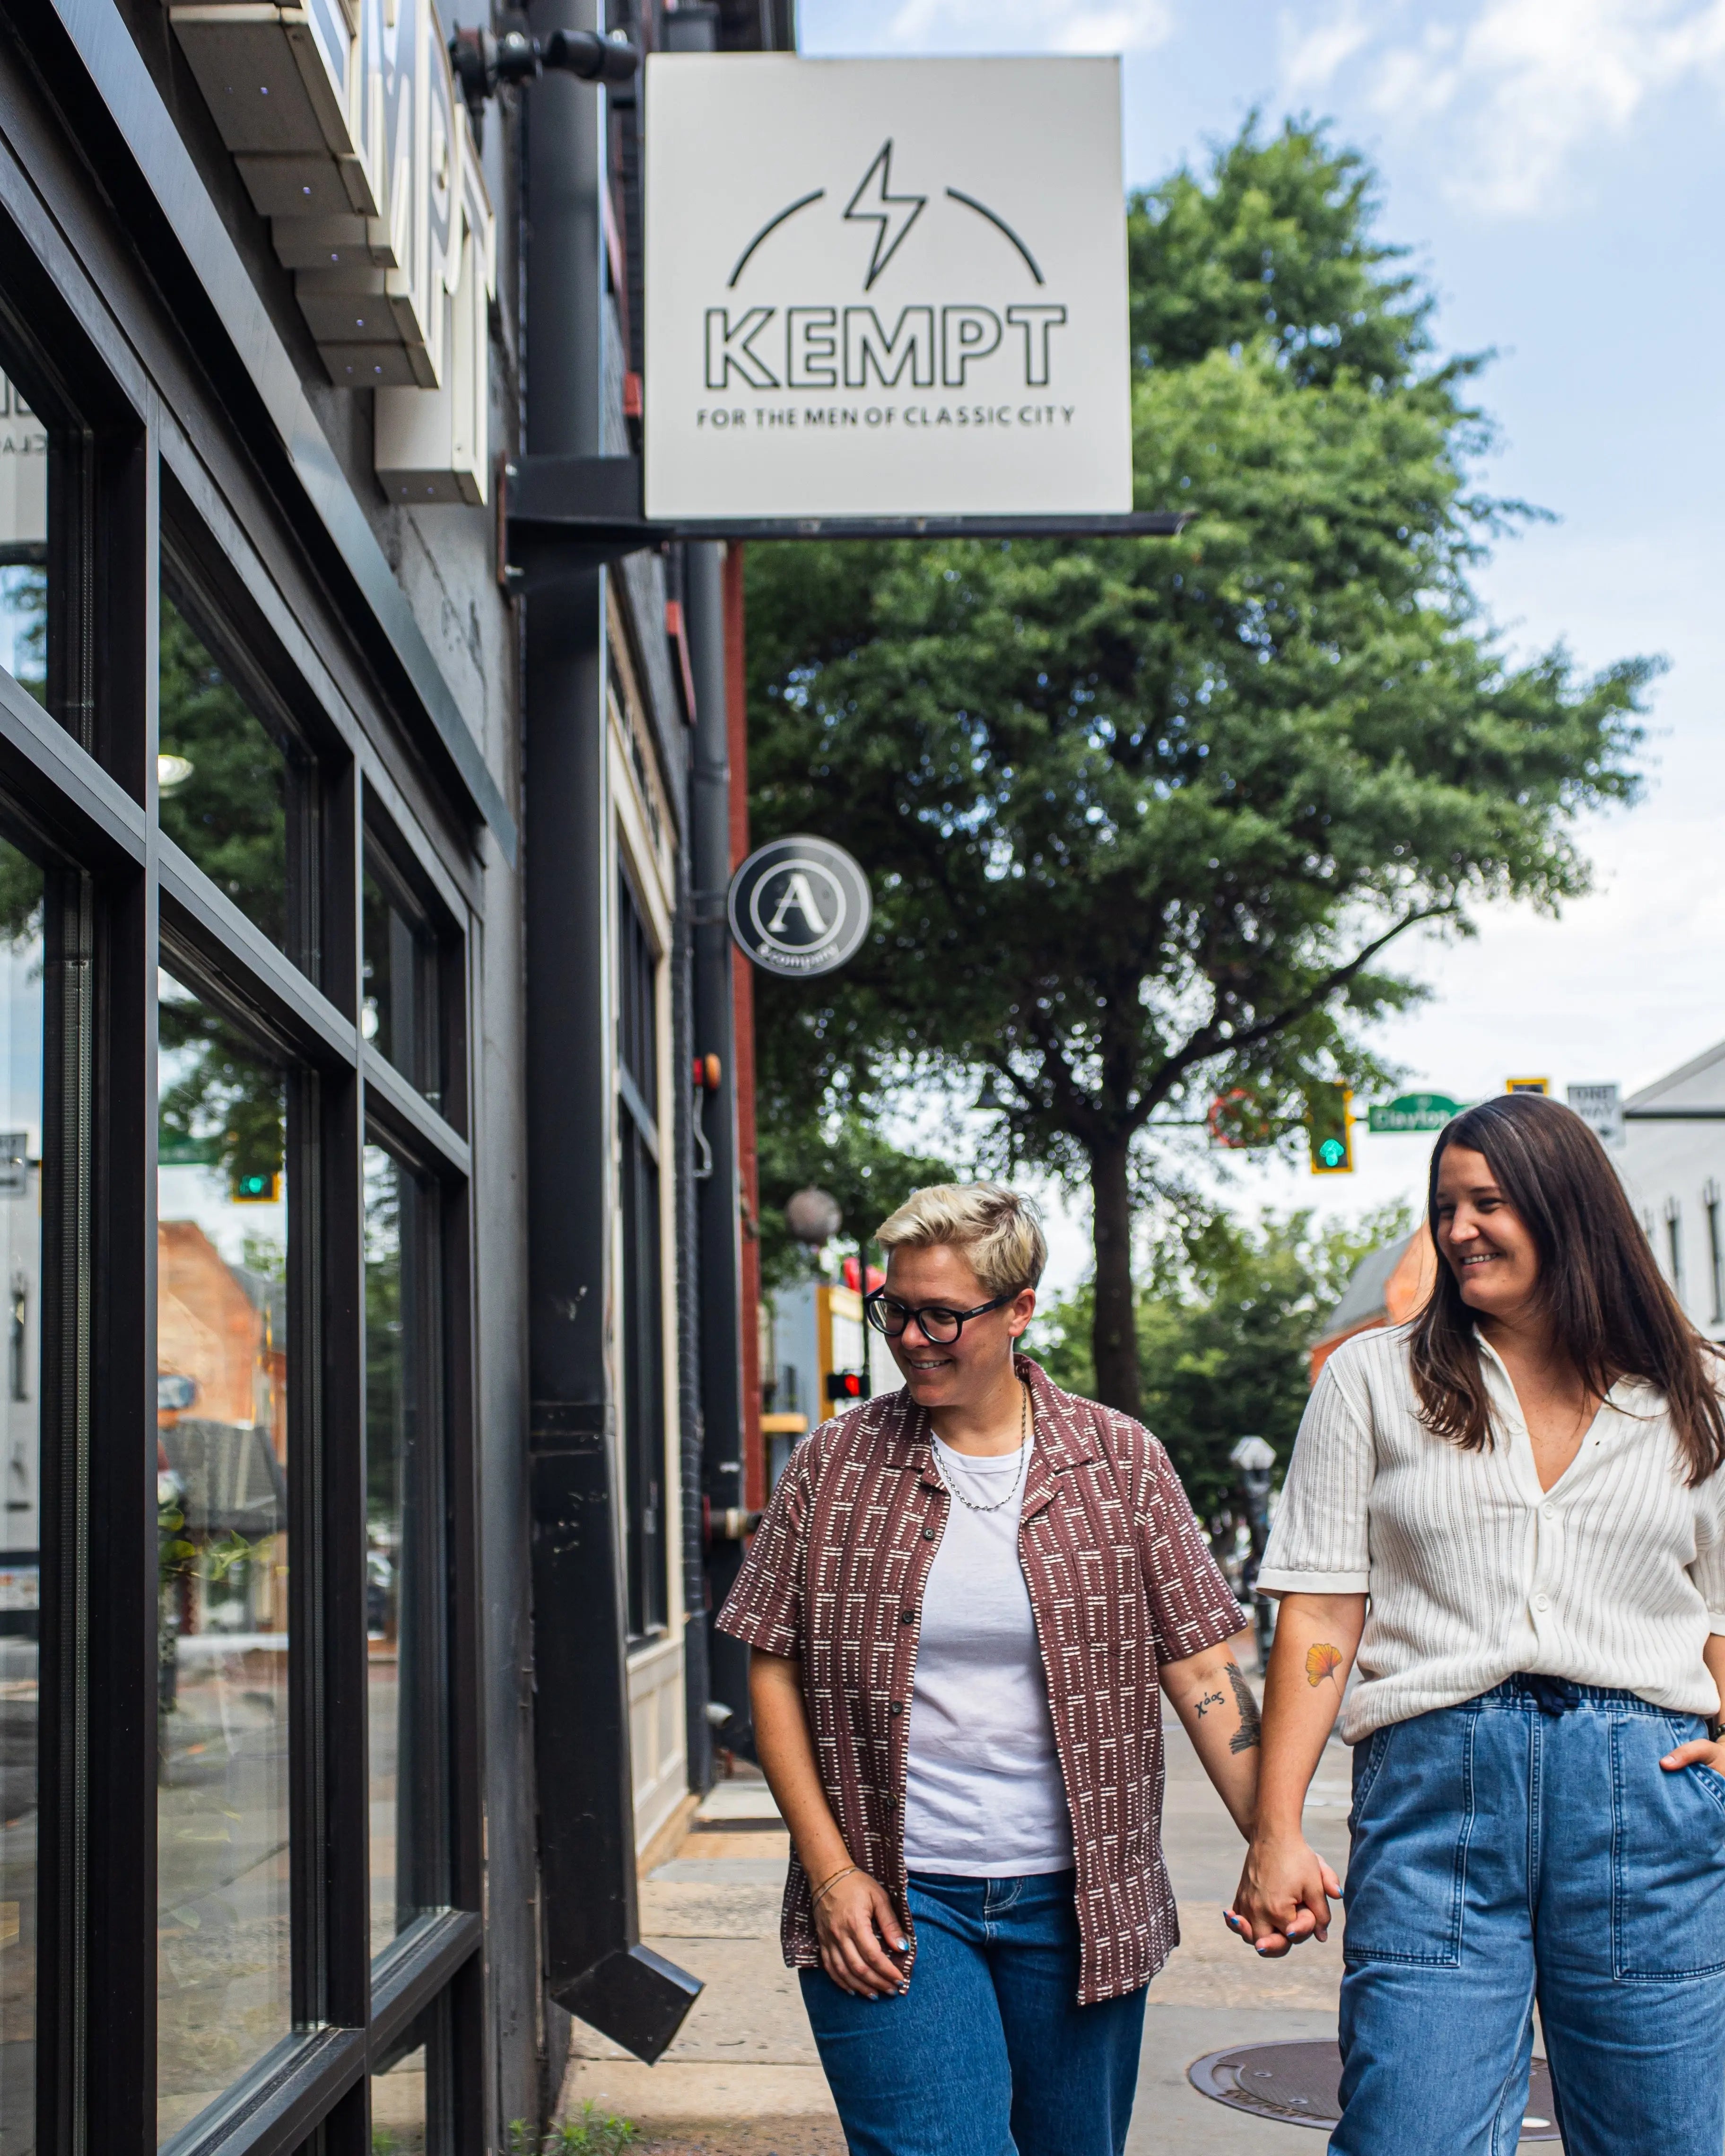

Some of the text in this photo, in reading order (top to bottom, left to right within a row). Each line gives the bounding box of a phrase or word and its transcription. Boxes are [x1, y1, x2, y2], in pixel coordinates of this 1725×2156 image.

[705, 304, 1068, 390] KEMPT
[697, 405, 1075, 428] FOR THE MEN OF CLASSIC CITY
[767, 873, 828, 934] A
